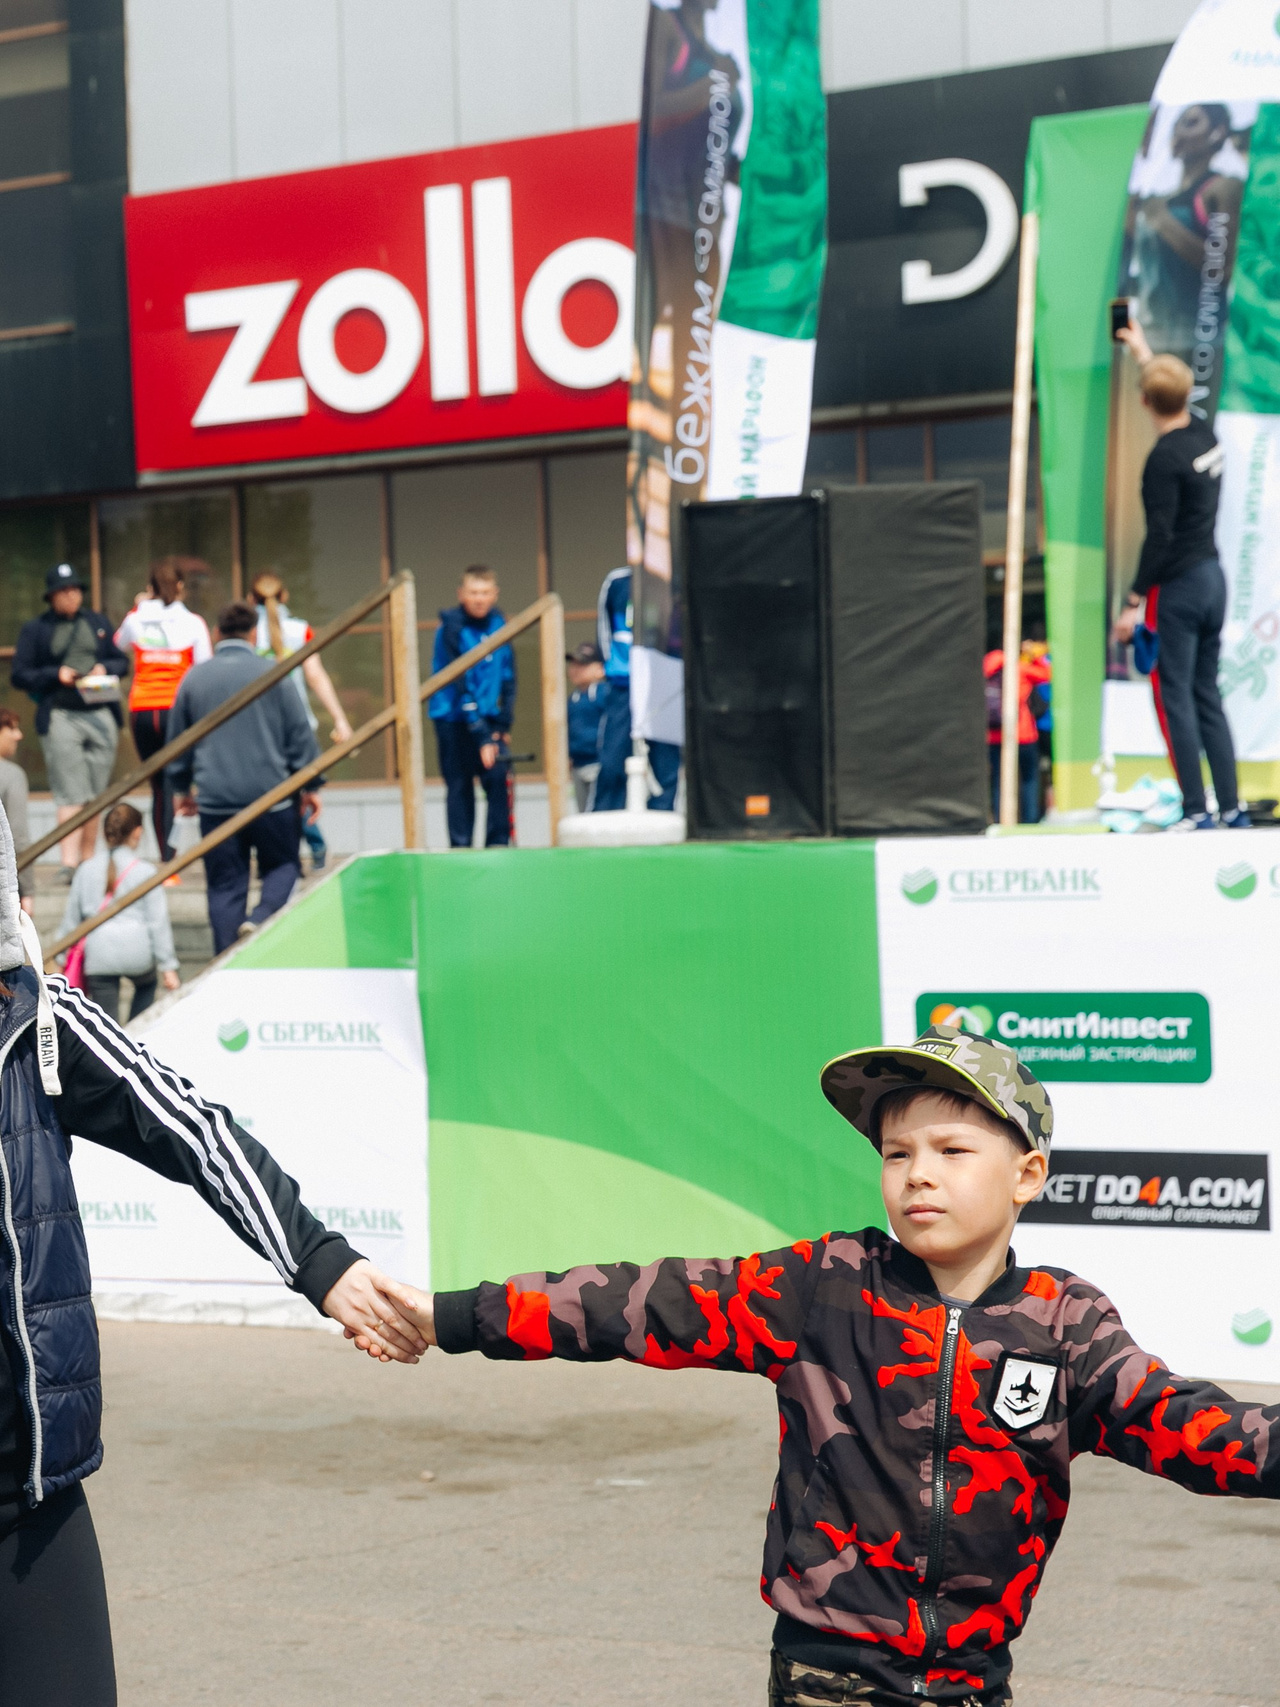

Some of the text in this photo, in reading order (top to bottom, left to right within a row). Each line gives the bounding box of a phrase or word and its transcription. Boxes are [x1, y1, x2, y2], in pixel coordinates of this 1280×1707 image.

[664, 279, 713, 484] бежим
[697, 68, 732, 225] смыслом
[185, 177, 636, 428] zolla
[948, 867, 1100, 893] СБЕРБАНК
[258, 1021, 381, 1044] СБЕРБАНК
[997, 1011, 1192, 1039] СмитИнвест
[40, 1026, 55, 1067] REMAIN
[1016, 1045, 1086, 1062] ДЕЖНЫЙ
[81, 1201, 158, 1222] РБАНК
[313, 1207, 403, 1230] ЕРБАНК
